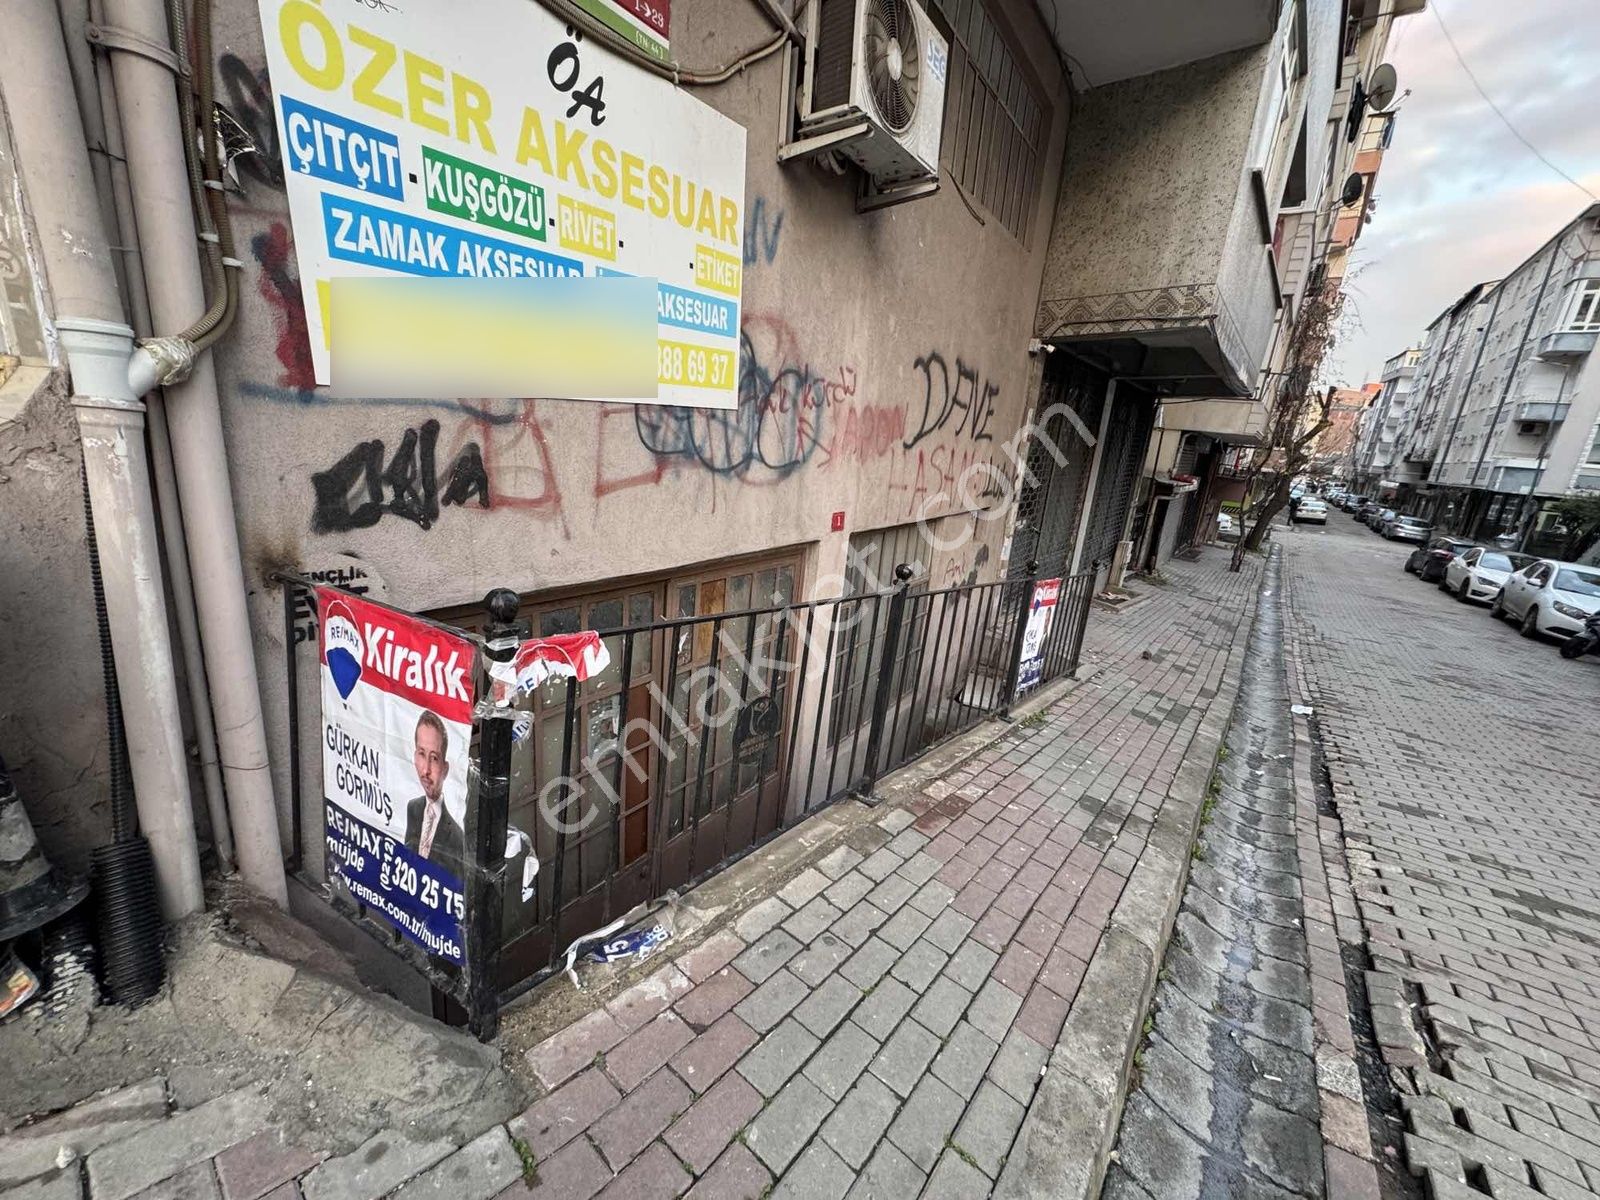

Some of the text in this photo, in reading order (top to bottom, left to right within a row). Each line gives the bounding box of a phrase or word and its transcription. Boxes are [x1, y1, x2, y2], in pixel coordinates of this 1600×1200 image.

[278, 0, 497, 156] ÖZER
[515, 104, 738, 247] AKSESUAR
[288, 112, 737, 289] ÇITÇIT KUŞGÖZÜ RİVET ETİKET
[331, 207, 450, 272] ZAMAK
[658, 290, 729, 331] AKSESUAR
[687, 349, 706, 384] 69
[711, 353, 728, 385] 37
[330, 626, 359, 649] RE/MAX
[364, 622, 470, 703] Kiralık
[326, 722, 379, 782] GÜRKAN
[336, 762, 393, 827] GÖRMÜŞ
[326, 835, 365, 873] müjde
[391, 856, 465, 921] 320 25 75
